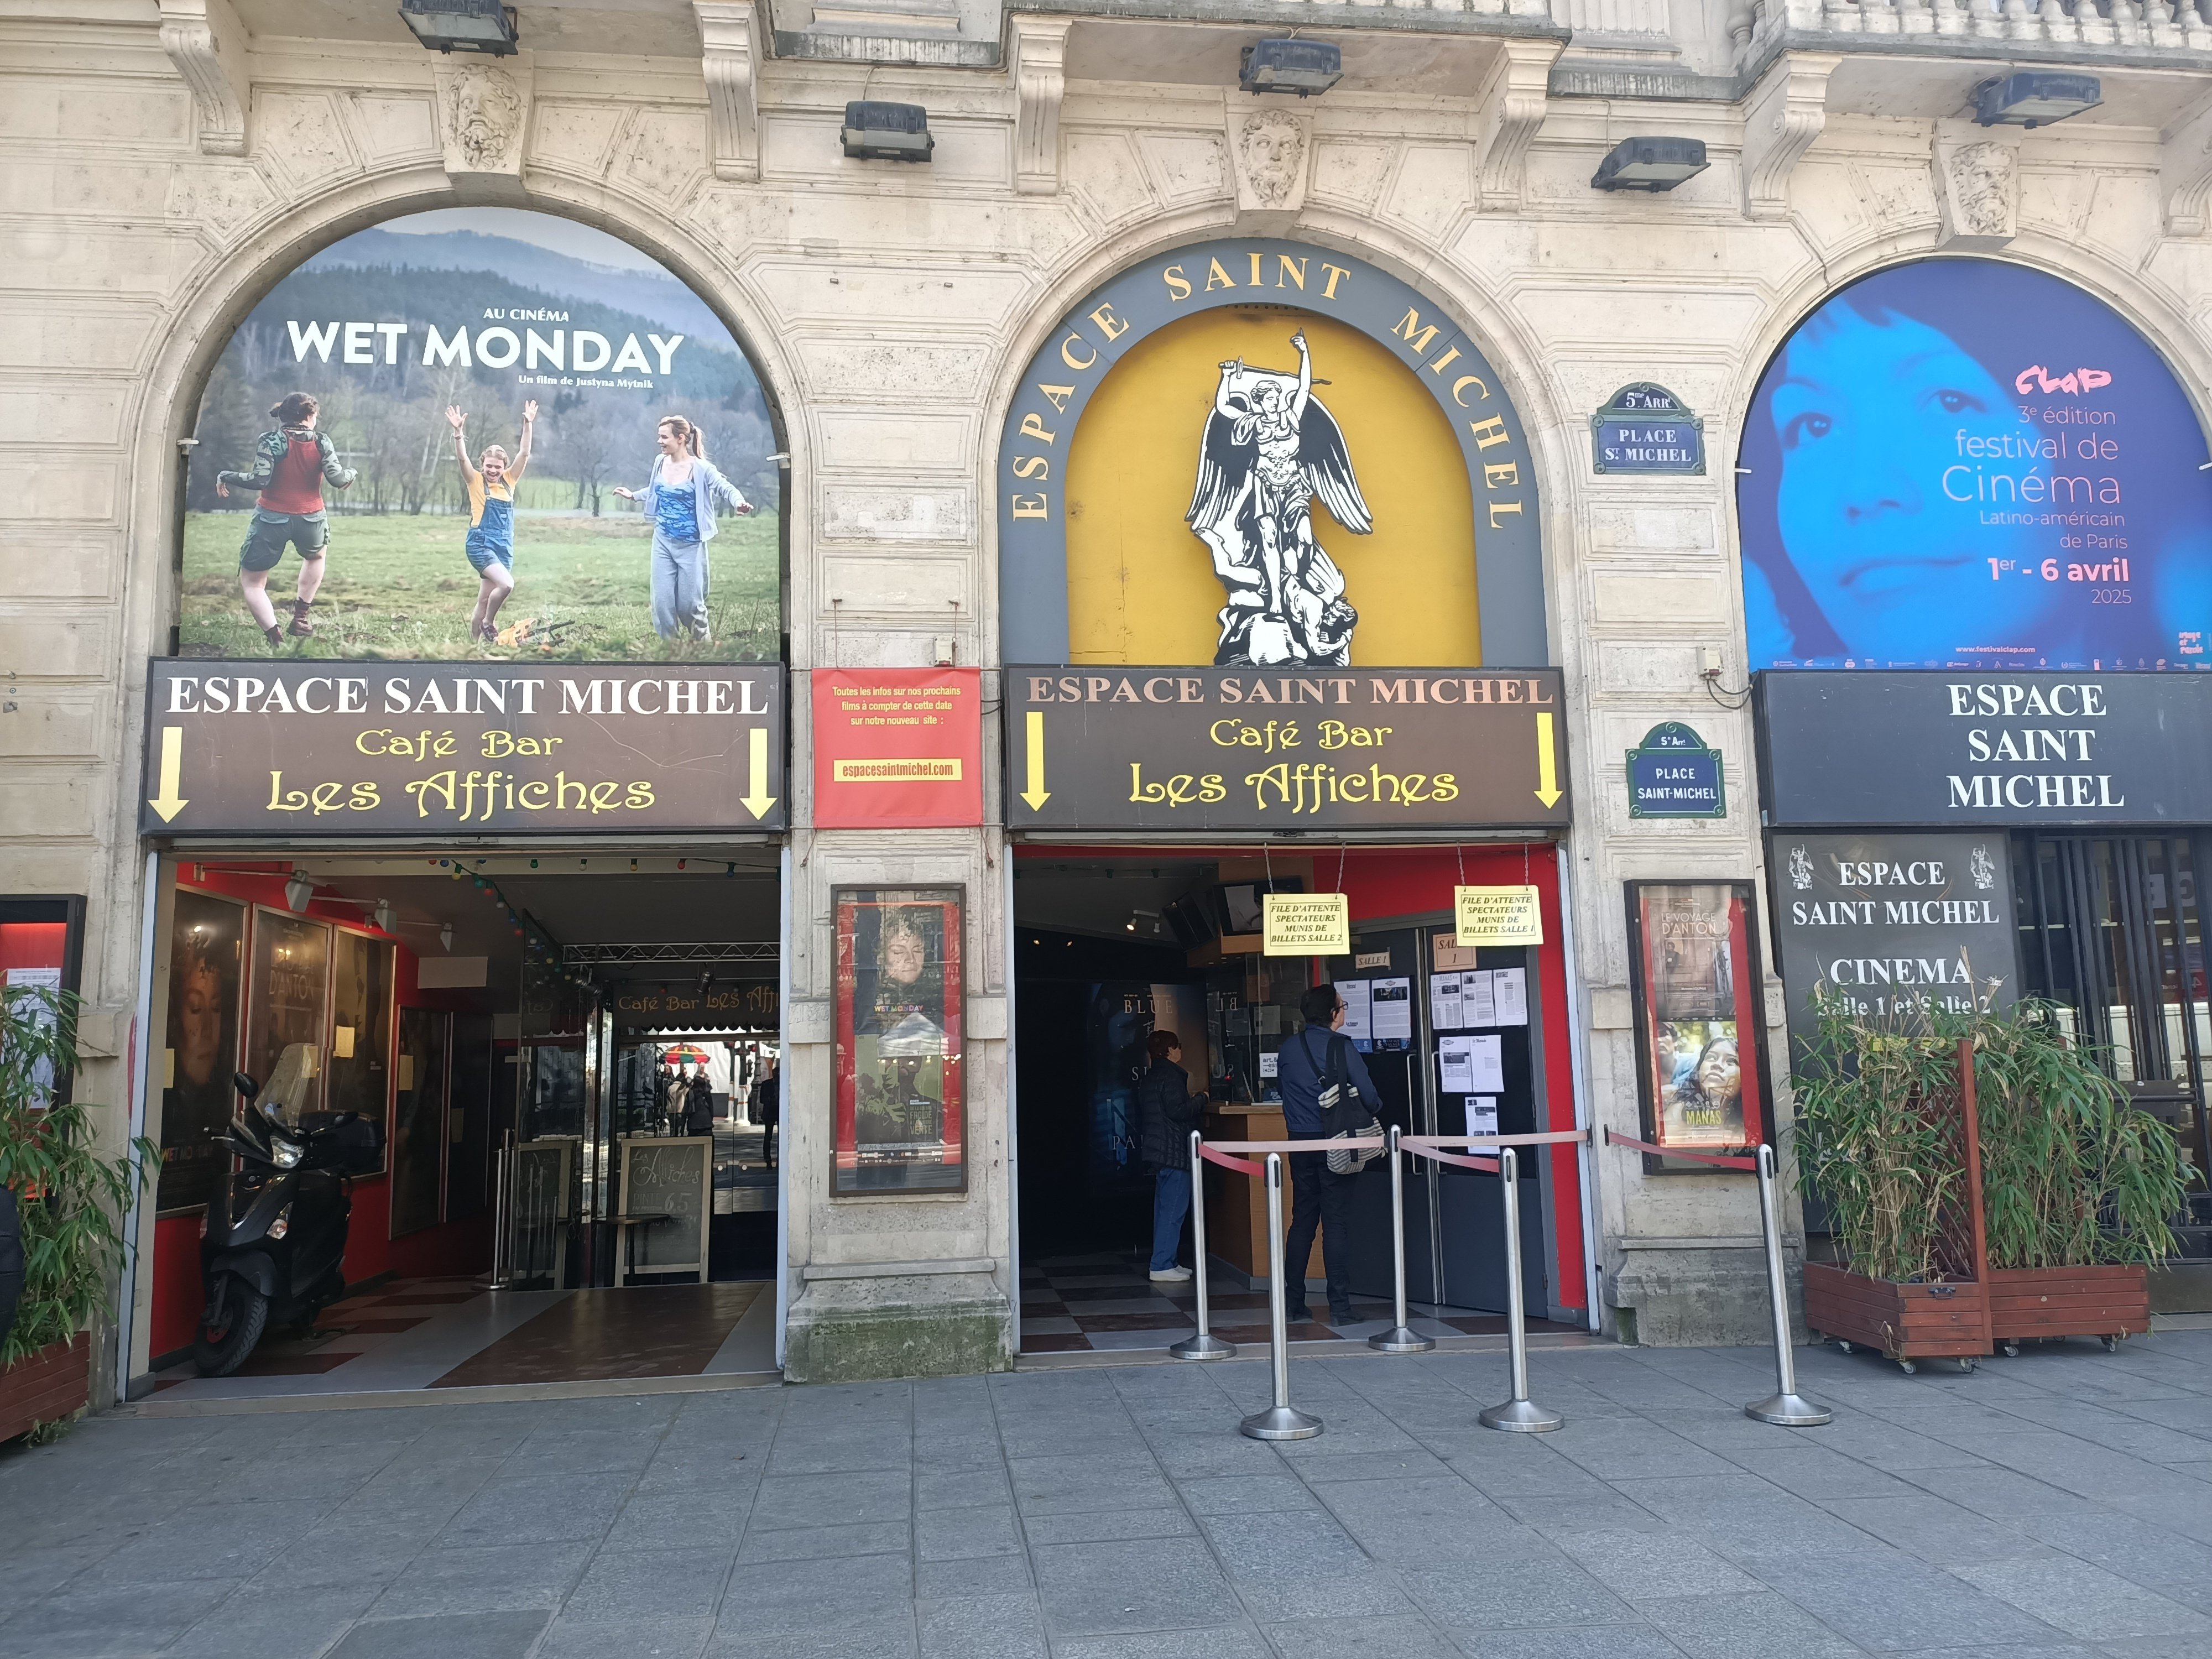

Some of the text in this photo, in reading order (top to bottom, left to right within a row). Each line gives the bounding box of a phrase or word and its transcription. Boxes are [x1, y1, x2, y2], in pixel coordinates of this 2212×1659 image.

[483, 306, 570, 322] AU CINÉMA
[287, 320, 685, 375] WET MONDAY
[518, 375, 654, 390] Un film de Justyna Mytnik
[1012, 252, 1523, 529] ESPACE SAINT MICHEL
[2018, 406, 2116, 425] 3e édition
[1619, 429, 1677, 442] PLACE
[1955, 429, 2119, 460] festival de
[1624, 448, 1692, 462] MICHEL
[1942, 465, 2120, 504] Cinéma
[1980, 510, 2125, 526] Latino-américain
[2060, 534, 2128, 549] de Paris
[1987, 557, 2016, 580] 1er
[2041, 558, 2059, 581] 6
[2067, 557, 2130, 582] avril
[2091, 589, 2132, 604] 2025
[1955, 645, 2036, 654] www.festivalclap.com
[165, 676, 768, 715] ESPACE SAINT MICHEL
[832, 686, 858, 696] Toutes
[859, 686, 872, 696] les
[873, 686, 891, 696] infos
[923, 686, 961, 697] prochains
[1026, 676, 1553, 704] ESPACE SAINT MICHEL
[841, 700, 952, 712] films à compter de cette date
[1945, 684, 2107, 717] ESPACE
[851, 717, 863, 726] sur
[865, 716, 885, 725] notre
[923, 716, 937, 724] site
[356, 728, 563, 761] Café Bar
[1209, 719, 1393, 754] Café Bar
[1968, 729, 2096, 762] SAINT
[842, 763, 953, 778] espacesaintmichel.com
[1656, 768, 1695, 779] PLACE
[266, 769, 655, 821] Les Affiches
[1129, 762, 1459, 814] Les Affiches
[1637, 787, 1717, 799] SAINT-MICHEL
[1945, 775, 2125, 807] MICHEL
[1838, 862, 1945, 886] ESPACE
[1661, 912, 1716, 922] LE VOYAGE
[1792, 900, 2000, 925] SAINT MICHEL
[1662, 922, 1717, 935] D'ANTON
[1438, 940, 1456, 950] SAL
[1358, 957, 1381, 966] SALLE
[1830, 958, 1974, 985] CINEMA
[618, 996, 659, 1013] Café
[666, 996, 700, 1011] Bar
[706, 992, 740, 1011] Les
[1124, 999, 1173, 1014] BLUE
[1875, 997, 1886, 1015] 1
[1895, 998, 1914, 1015] et
[1979, 995, 1991, 1015] 2
[1686, 1110, 1723, 1125] MANAS
